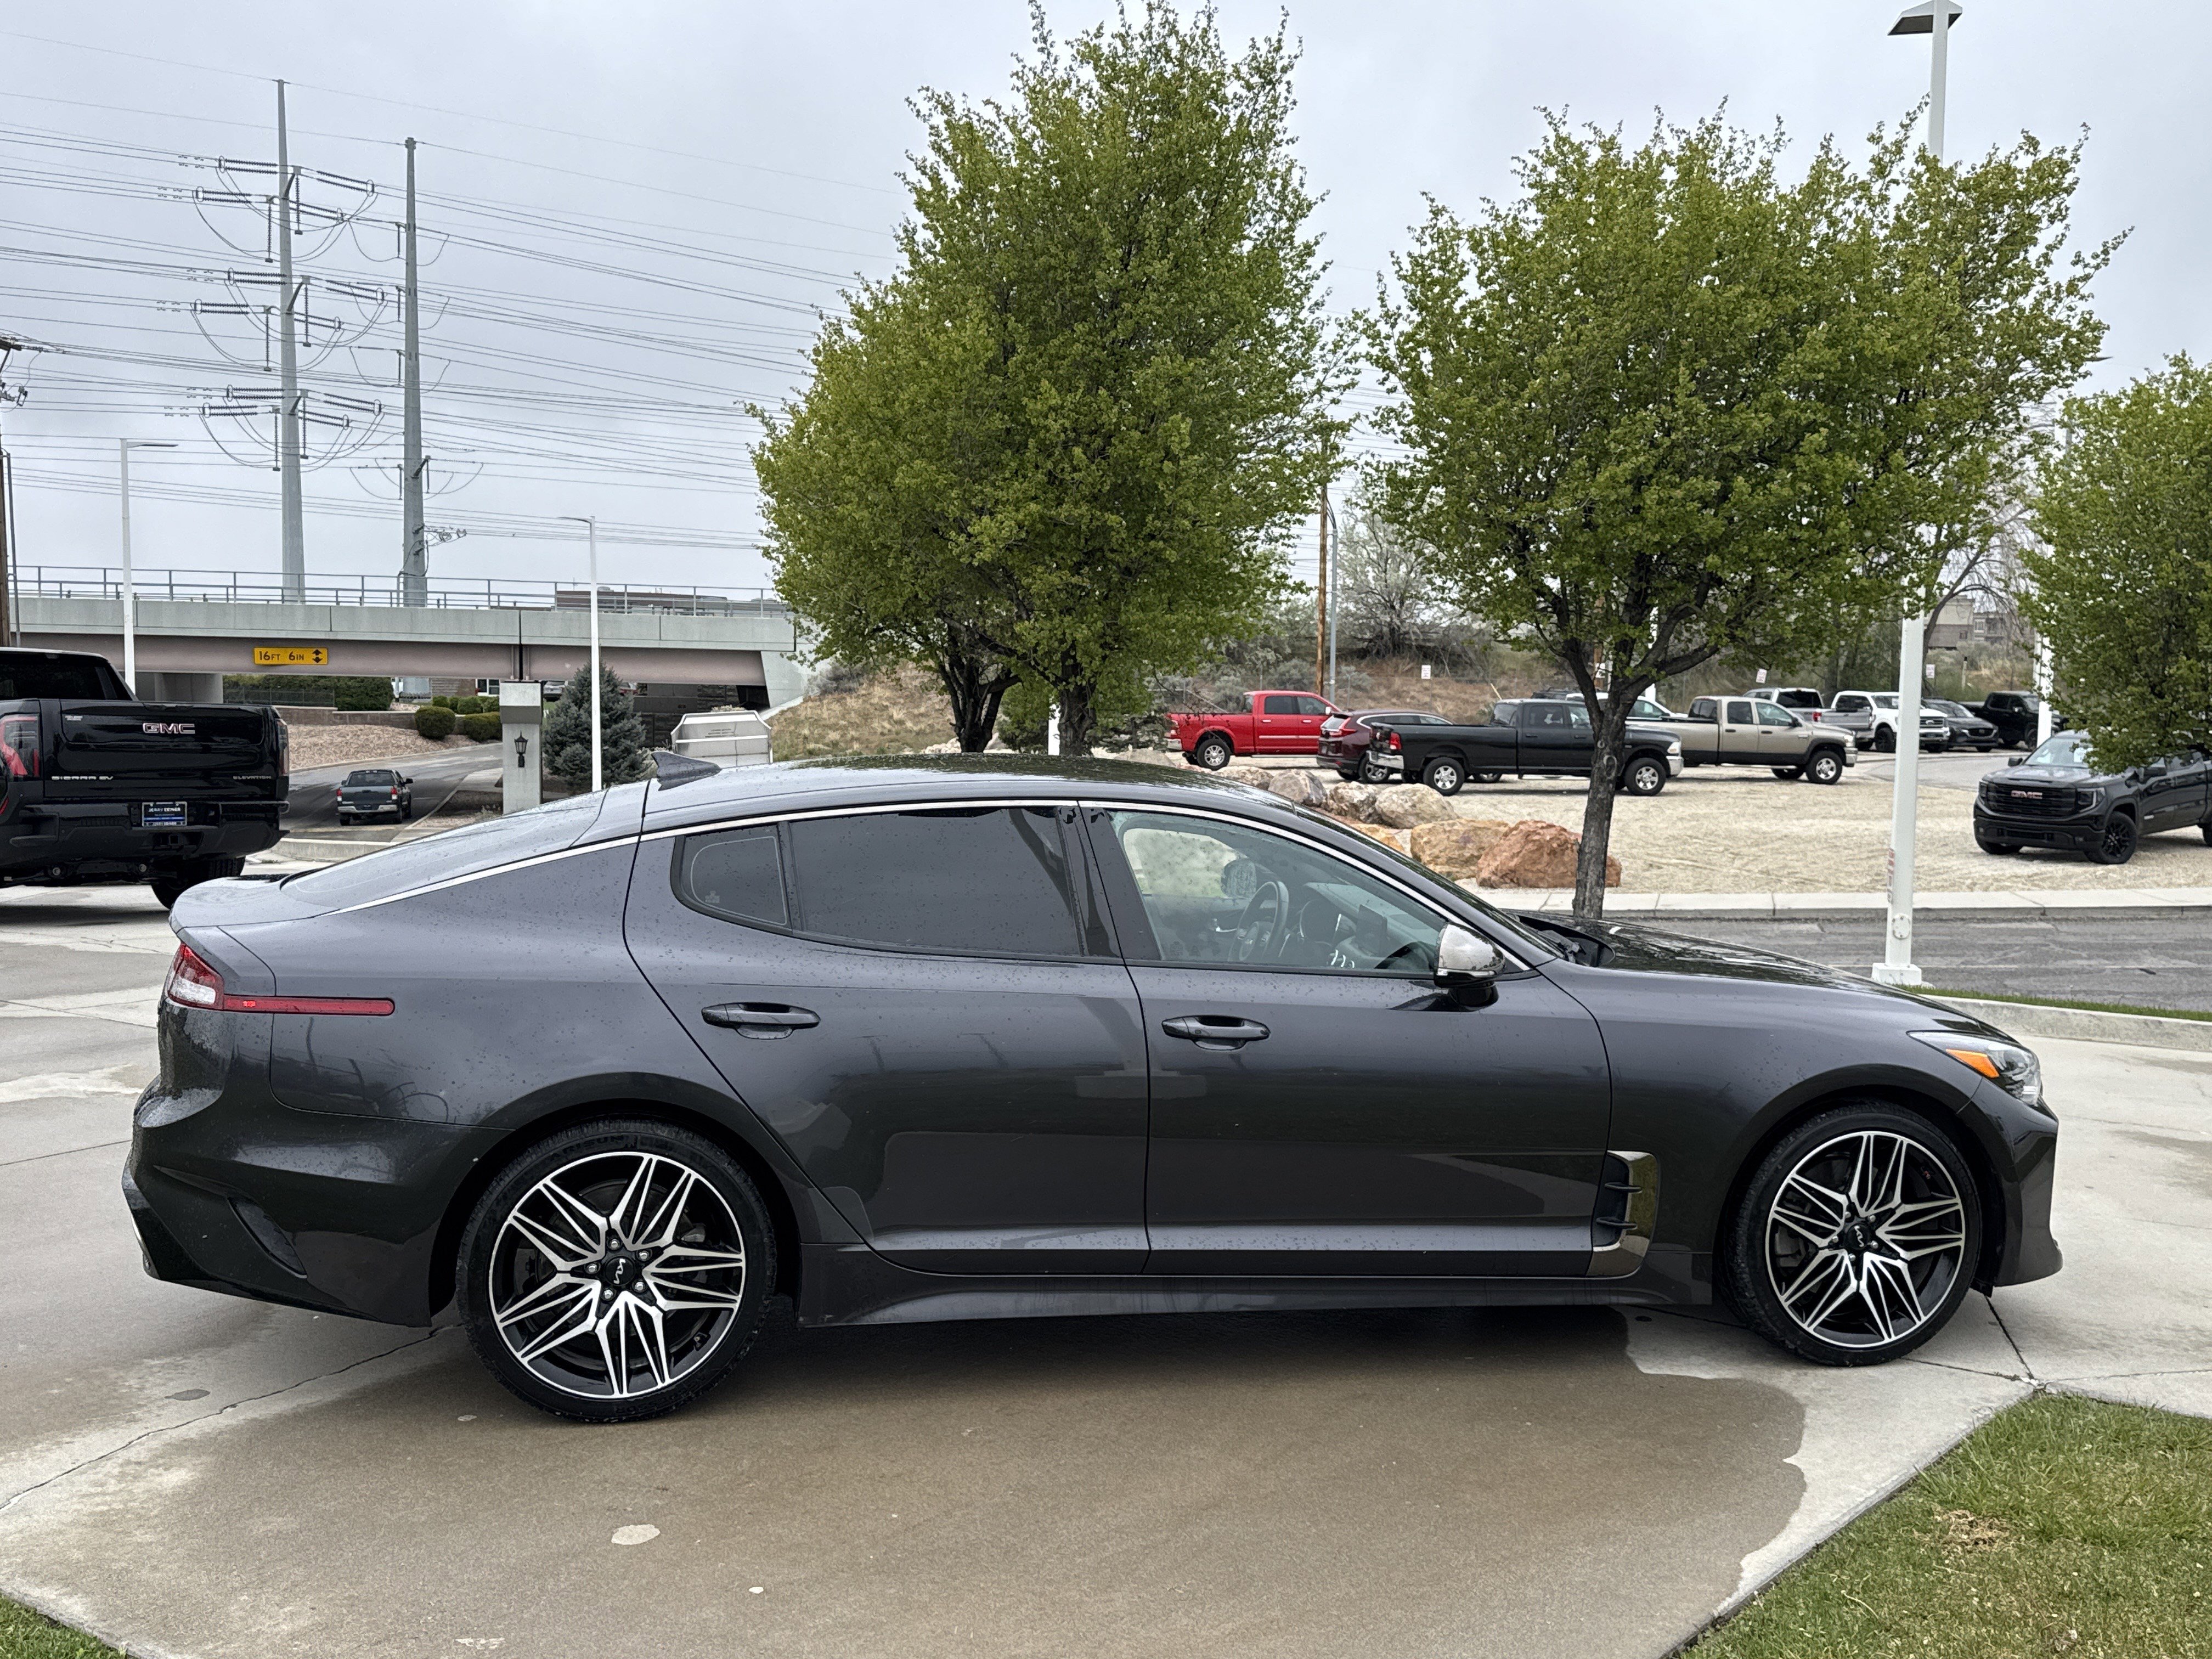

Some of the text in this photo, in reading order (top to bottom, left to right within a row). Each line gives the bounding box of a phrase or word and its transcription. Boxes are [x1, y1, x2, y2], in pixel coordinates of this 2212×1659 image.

[259, 651, 304, 661] 16FT 6IN
[143, 723, 195, 734] GMC
[2011, 790, 2042, 799] GMC
